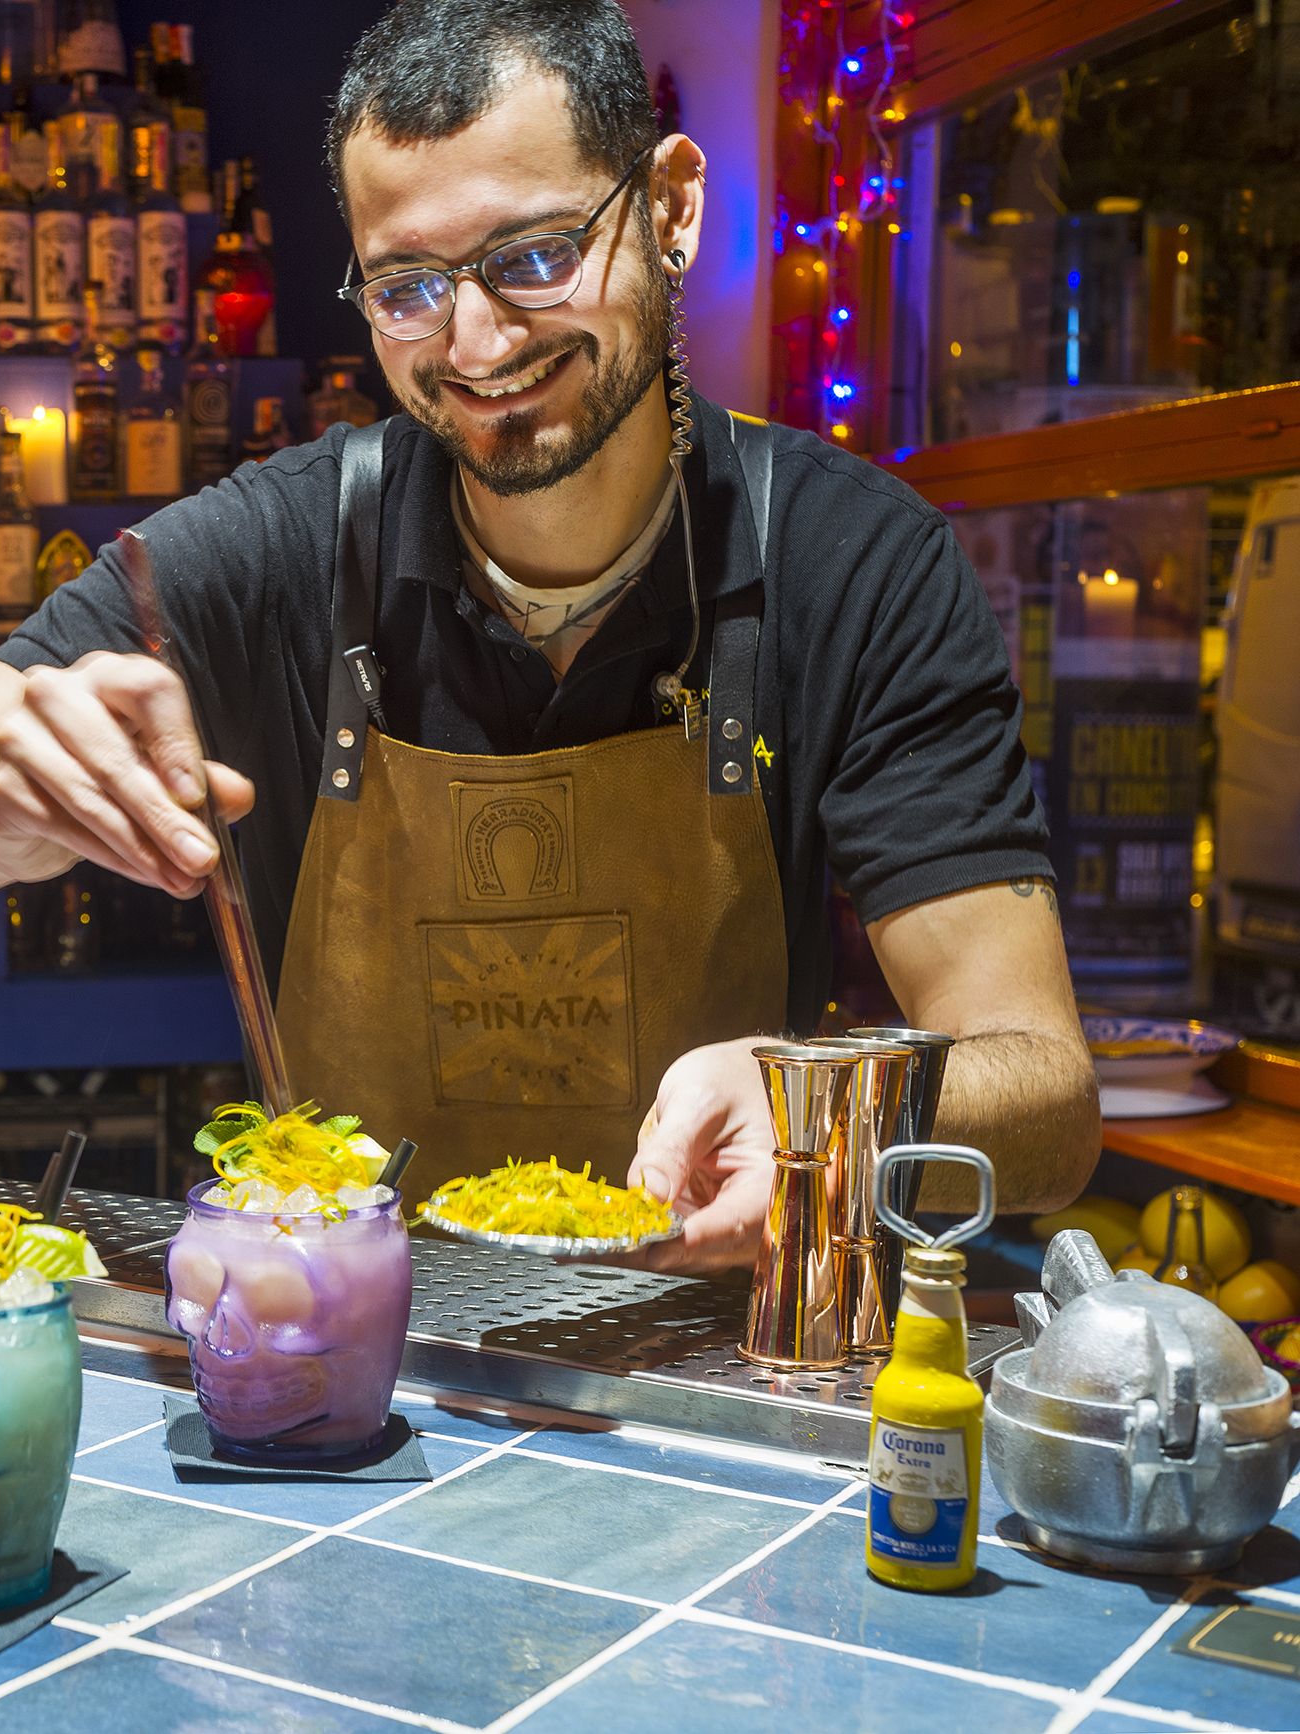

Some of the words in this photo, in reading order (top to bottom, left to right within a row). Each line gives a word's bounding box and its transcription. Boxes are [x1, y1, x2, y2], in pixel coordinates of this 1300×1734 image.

[475, 806, 552, 836] HERRADURA
[450, 991, 613, 1031] PIÑATA
[882, 1429, 946, 1456] Corona
[896, 1451, 932, 1469] Extra
